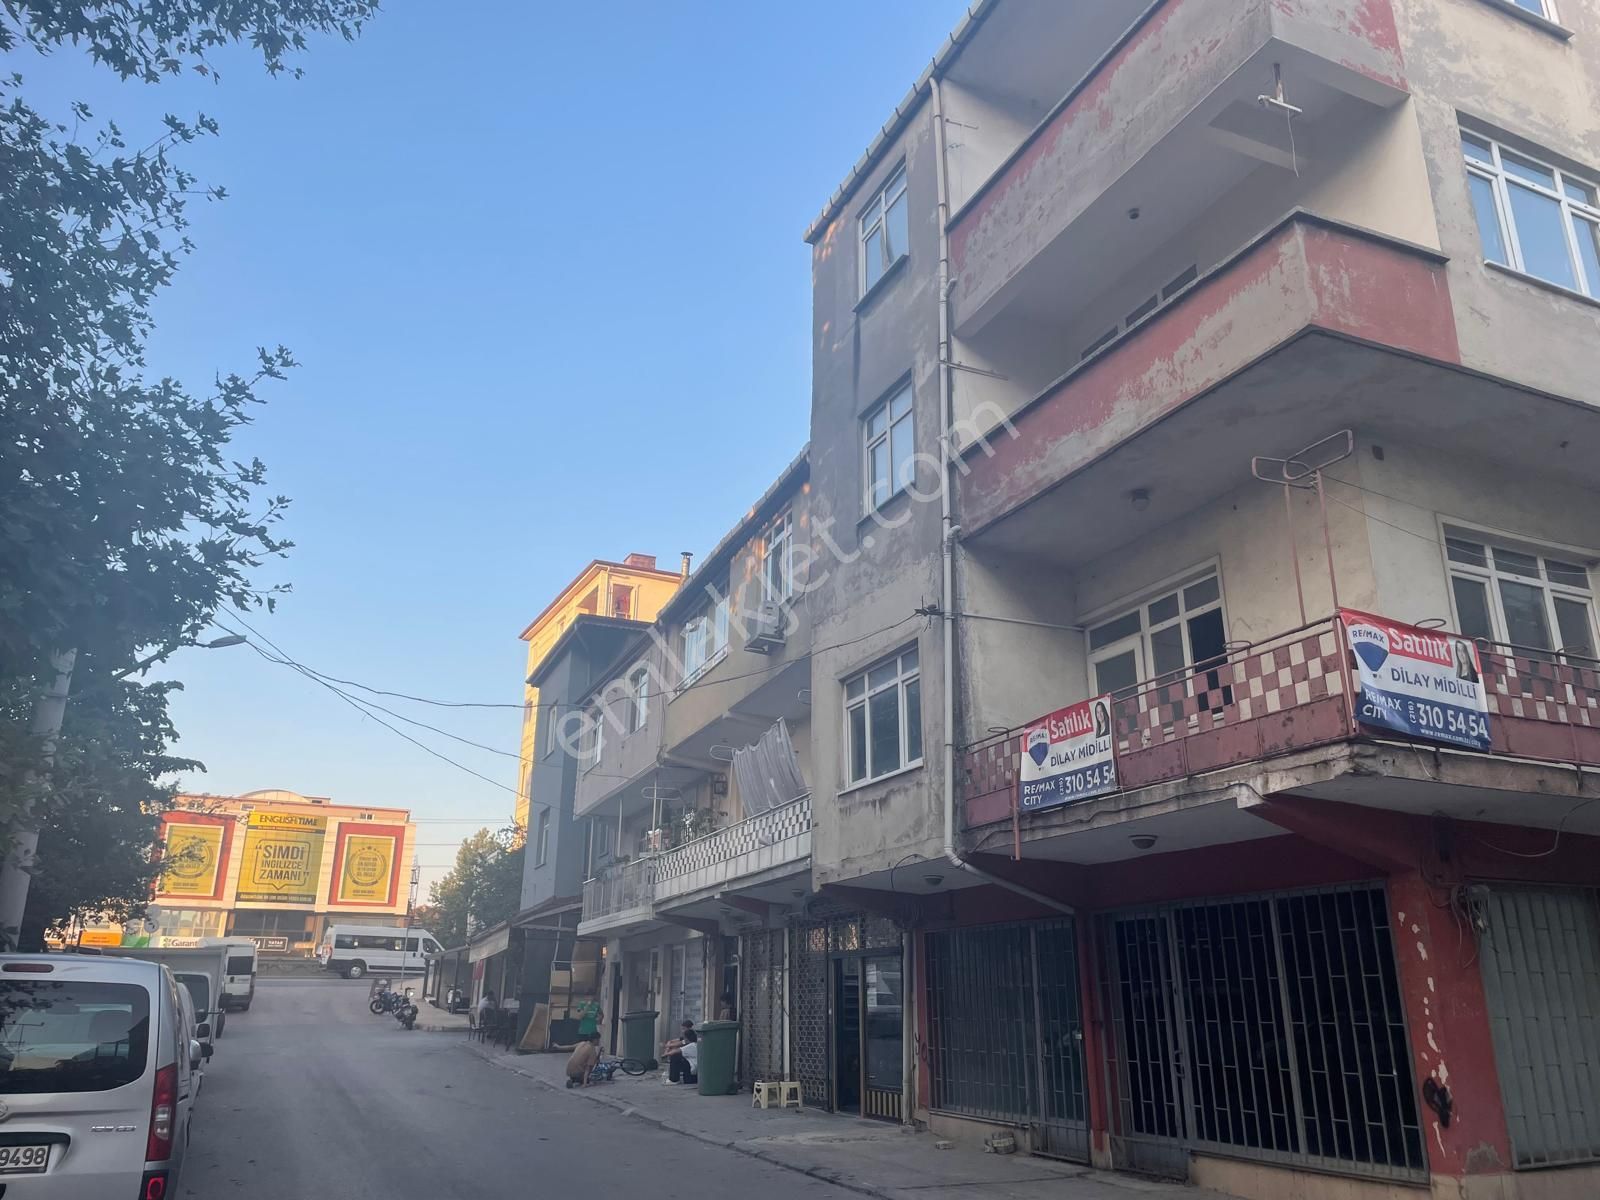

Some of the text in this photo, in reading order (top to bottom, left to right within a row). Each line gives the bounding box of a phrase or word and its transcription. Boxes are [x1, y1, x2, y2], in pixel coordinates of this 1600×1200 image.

[1352, 627, 1385, 644] RE/MAX
[1388, 627, 1451, 662] Satılık
[1391, 667, 1477, 699] DİLAY MİDİLLİ
[1365, 688, 1402, 711] RE/MAX
[1362, 704, 1387, 720] CITY
[1417, 703, 1444, 729] 310
[1447, 709, 1467, 734] 54
[1469, 716, 1489, 739] 54
[1051, 709, 1092, 740] Satılık
[1050, 748, 1077, 767] DİLAY
[1024, 780, 1056, 795] RE/MAX
[1065, 773, 1084, 794] 310
[1086, 768, 1100, 789] 54
[1024, 794, 1042, 806] CITY
[298, 817, 317, 826] TIME
[0, 1147, 46, 1167] 9498
